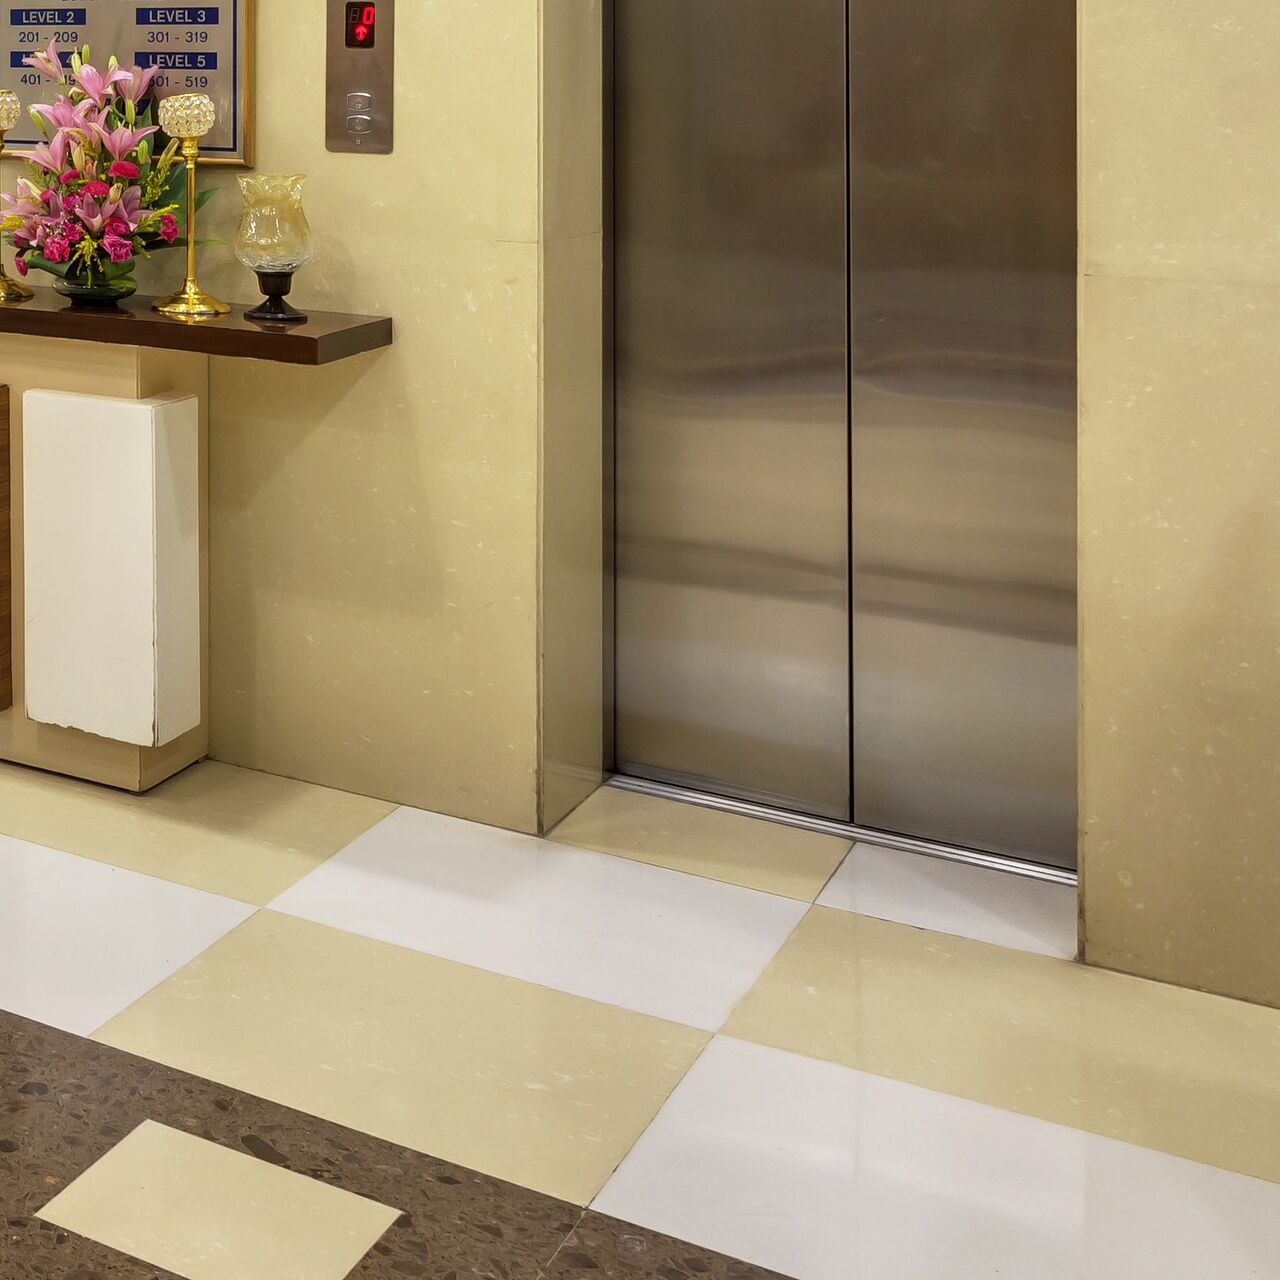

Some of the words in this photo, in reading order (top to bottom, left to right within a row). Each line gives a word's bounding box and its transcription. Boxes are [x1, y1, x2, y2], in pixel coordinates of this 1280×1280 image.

[22, 11, 62, 24] LEVEL
[66, 11, 75, 23] 2
[149, 10, 193, 23] LEVEL
[197, 10, 206, 23] 3
[362, 6, 376, 25] 0
[18, 32, 40, 43] 201
[54, 31, 78, 43] 209
[147, 31, 170, 43] 301
[185, 31, 208, 43] 319
[149, 54, 192, 67] LEVEL
[197, 54, 206, 67] 5
[20, 74, 41, 86] 401
[185, 76, 208, 88] 519
